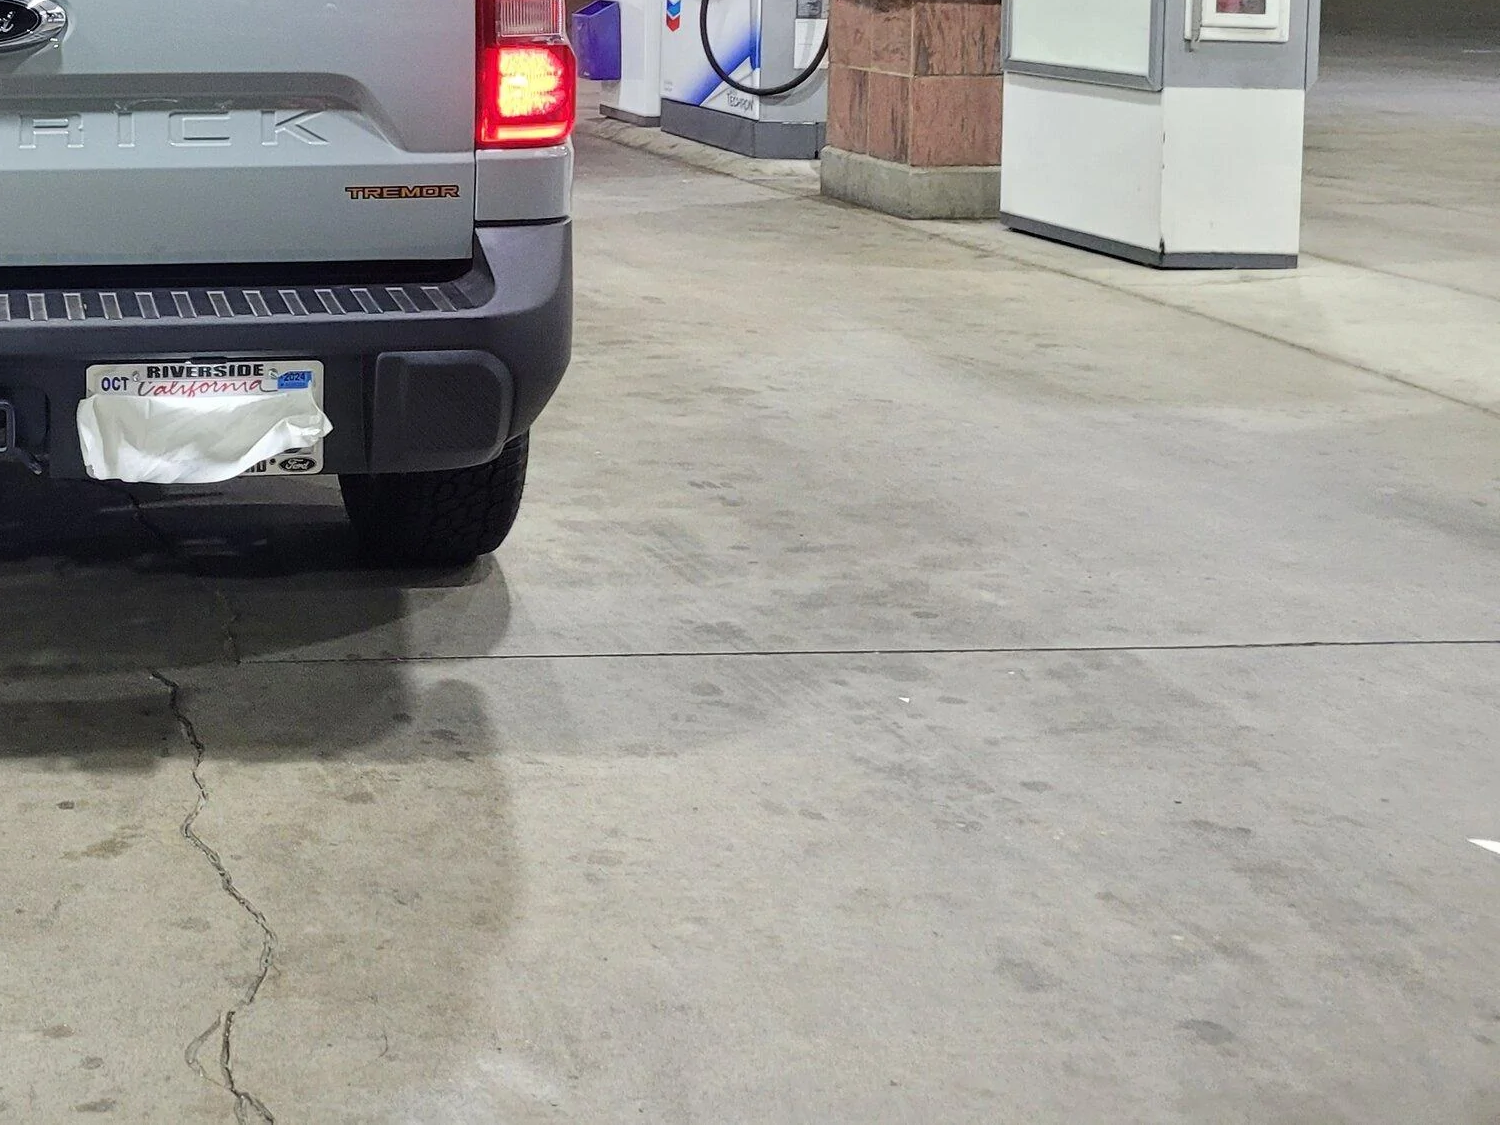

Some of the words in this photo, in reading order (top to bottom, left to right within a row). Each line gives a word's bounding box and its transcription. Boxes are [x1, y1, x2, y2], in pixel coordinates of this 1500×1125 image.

[345, 185, 460, 200] TREMOR
[146, 363, 264, 379] RIVERSIDE
[101, 376, 130, 392] OCT
[137, 378, 278, 397] California
[285, 458, 310, 471] Ford
